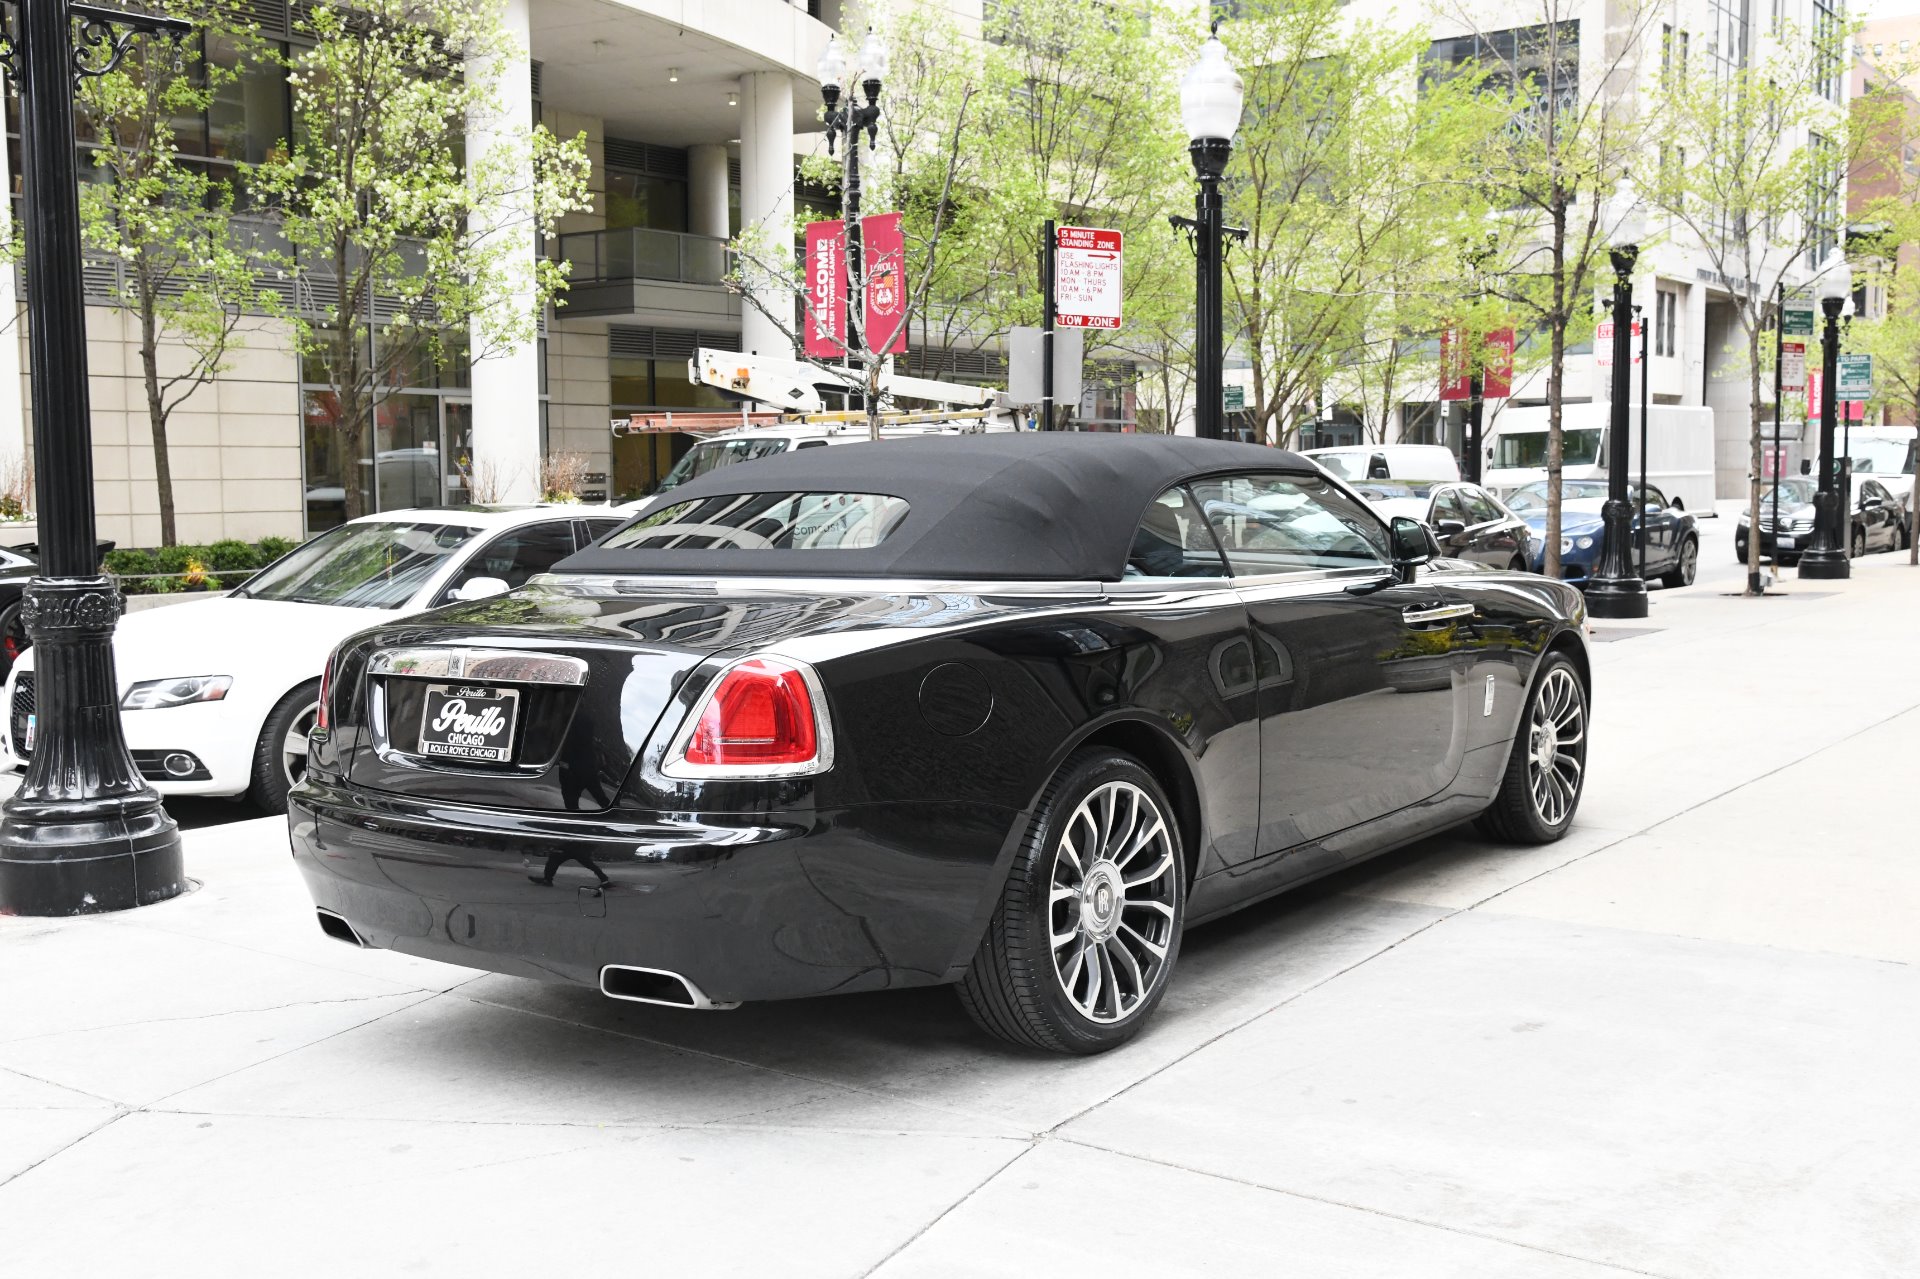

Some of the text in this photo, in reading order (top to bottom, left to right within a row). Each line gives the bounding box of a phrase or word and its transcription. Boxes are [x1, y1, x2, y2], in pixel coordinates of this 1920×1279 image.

[1061, 229, 1095, 240] 15 MINUTE
[1061, 238, 1115, 249] STANDING ZONE
[1060, 251, 1074, 260] USE
[1060, 261, 1118, 271] FLASHING LIGHTS
[1084, 278, 1107, 287] THURS
[816, 238, 828, 340] WELCOME
[1079, 294, 1093, 302] SUN
[1060, 315, 1115, 328] TOW ZONE
[456, 687, 487, 697] Perillo
[432, 699, 506, 736] Perillo
[447, 732, 485, 746] CHICAGO
[429, 744, 497, 758] ROLLS ROYCE CHICAGO
